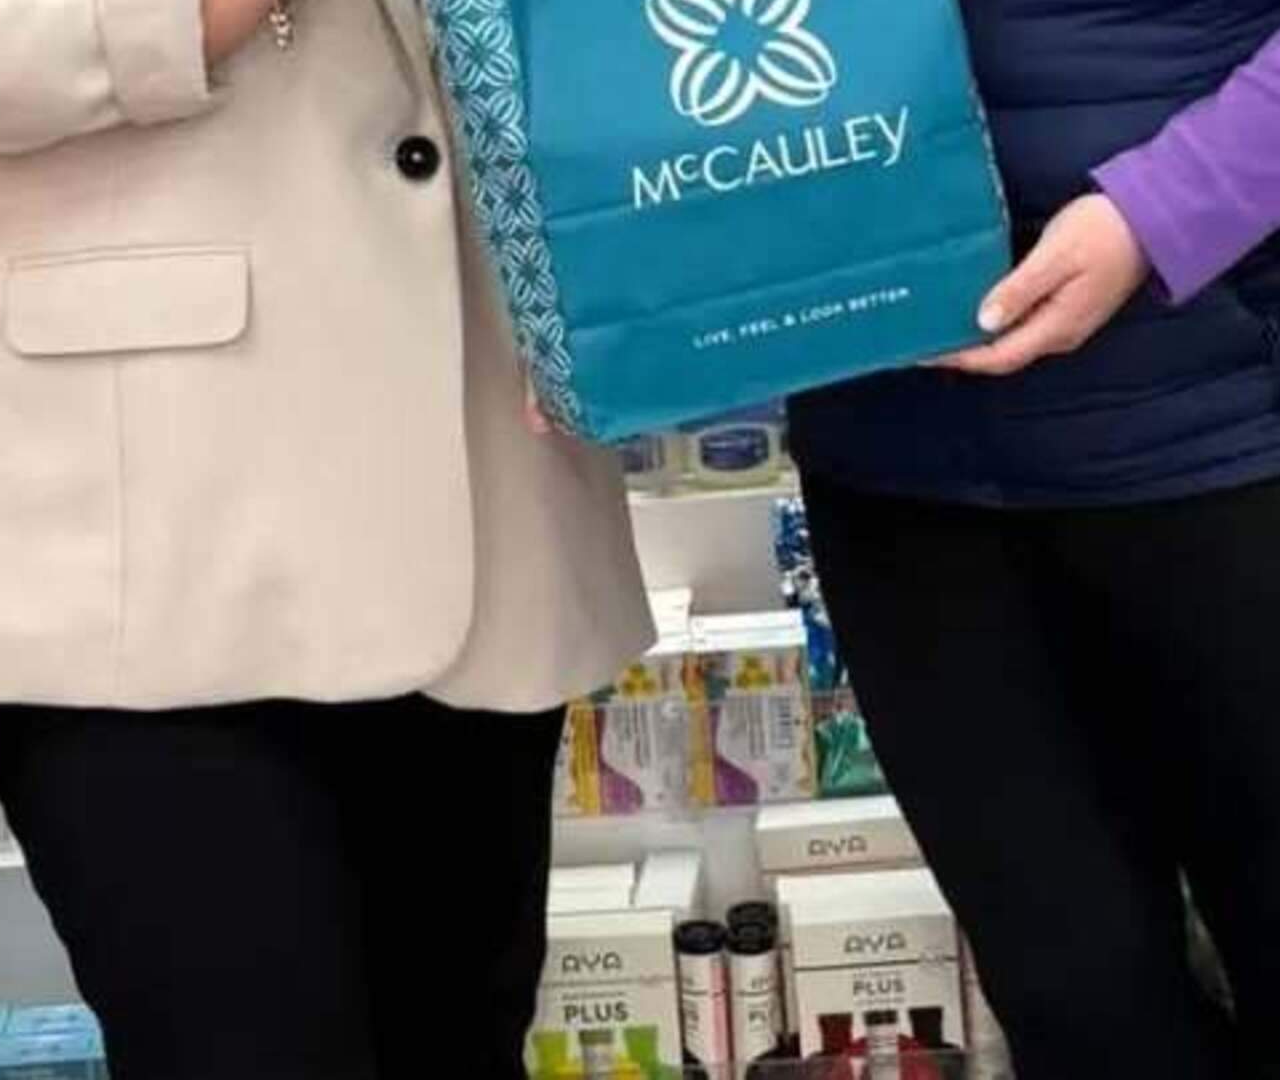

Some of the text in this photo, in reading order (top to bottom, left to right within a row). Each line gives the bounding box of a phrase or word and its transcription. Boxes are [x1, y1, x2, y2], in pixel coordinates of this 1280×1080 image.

[631, 106, 909, 209] McCAULEY
[739, 319, 778, 337] FEEL
[783, 314, 796, 327] &
[800, 302, 844, 324] LOOK
[848, 286, 910, 313] BETTER
[852, 977, 906, 997] PLUS
[563, 1001, 629, 1024] PLUS
